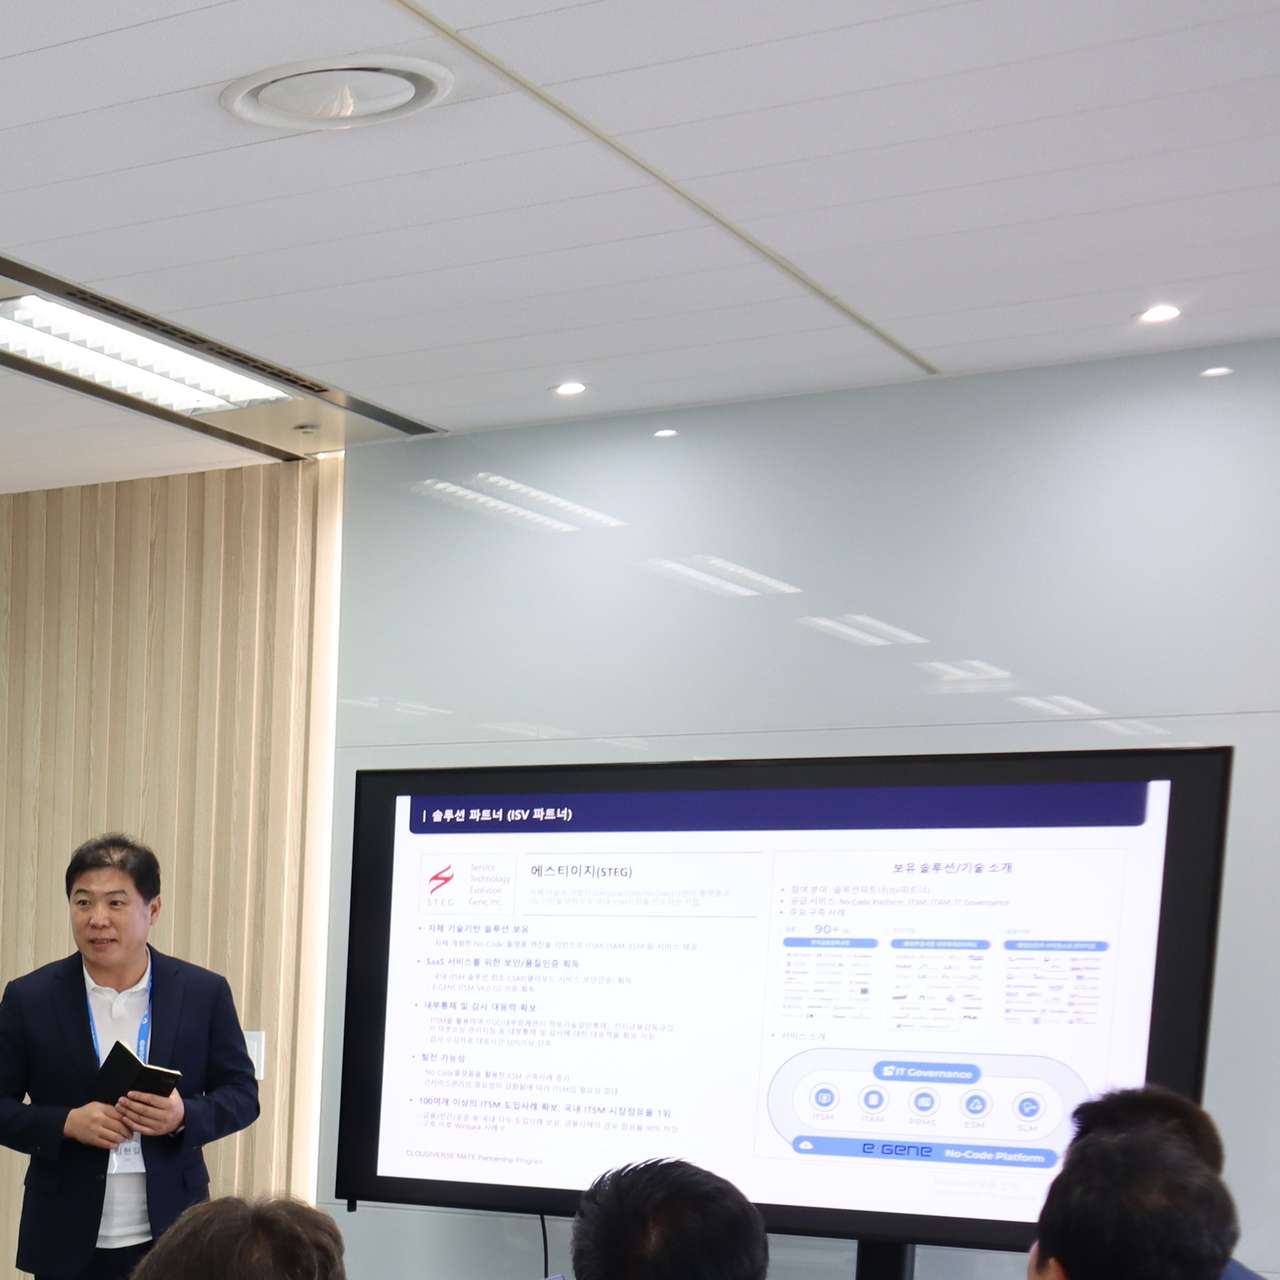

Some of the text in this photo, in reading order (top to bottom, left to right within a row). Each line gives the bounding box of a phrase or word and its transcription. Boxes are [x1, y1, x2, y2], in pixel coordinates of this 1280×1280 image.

[432, 807, 572, 823] 솔루션 파트너 (ISV 파트너)
[530, 864, 633, 880] 에스티이지(STEG)
[919, 861, 984, 875] 솔루션/기술
[988, 862, 1013, 874] 소개
[896, 1067, 973, 1080] IT Governance
[944, 1148, 994, 1161] No-Code
[995, 1151, 1046, 1164] Platform
